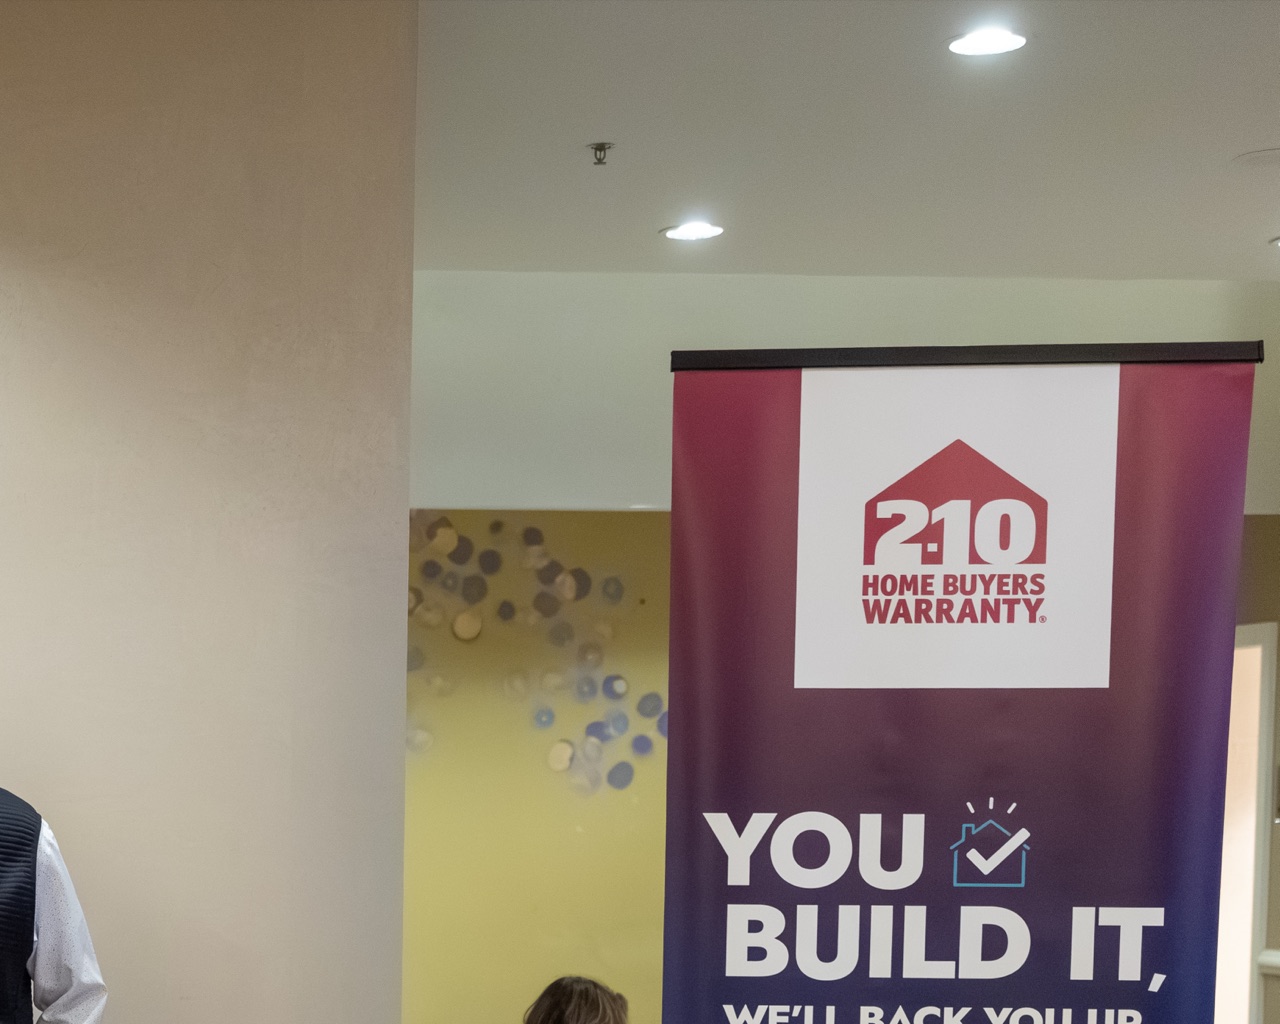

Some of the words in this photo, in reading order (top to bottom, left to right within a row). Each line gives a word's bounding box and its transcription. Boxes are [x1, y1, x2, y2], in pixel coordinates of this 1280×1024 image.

[861, 573, 935, 597] HOME
[942, 573, 1046, 597] BUYERS
[702, 810, 926, 891] YOU
[725, 903, 1032, 982] BUILD
[1069, 906, 1167, 993] IT,
